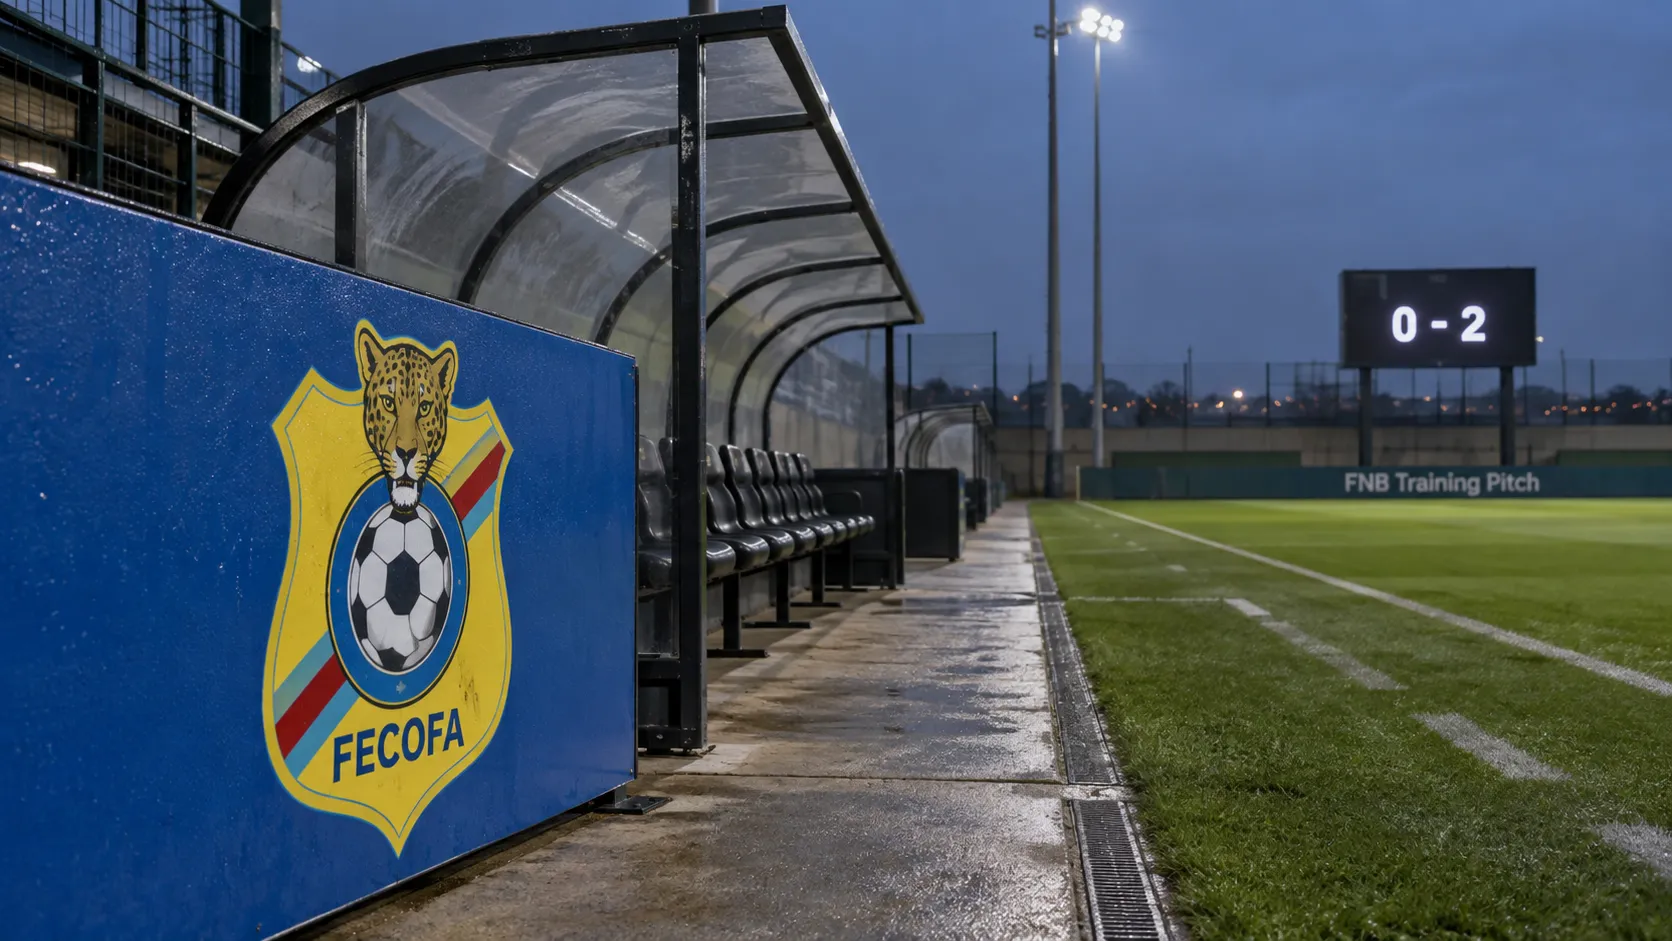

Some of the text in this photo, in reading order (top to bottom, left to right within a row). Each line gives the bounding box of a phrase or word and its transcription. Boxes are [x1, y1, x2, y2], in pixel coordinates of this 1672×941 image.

[1392, 305, 1486, 342] 0 - 2
[1344, 472, 1540, 496] FNB Training Pitch
[333, 708, 464, 783] FECOFA
